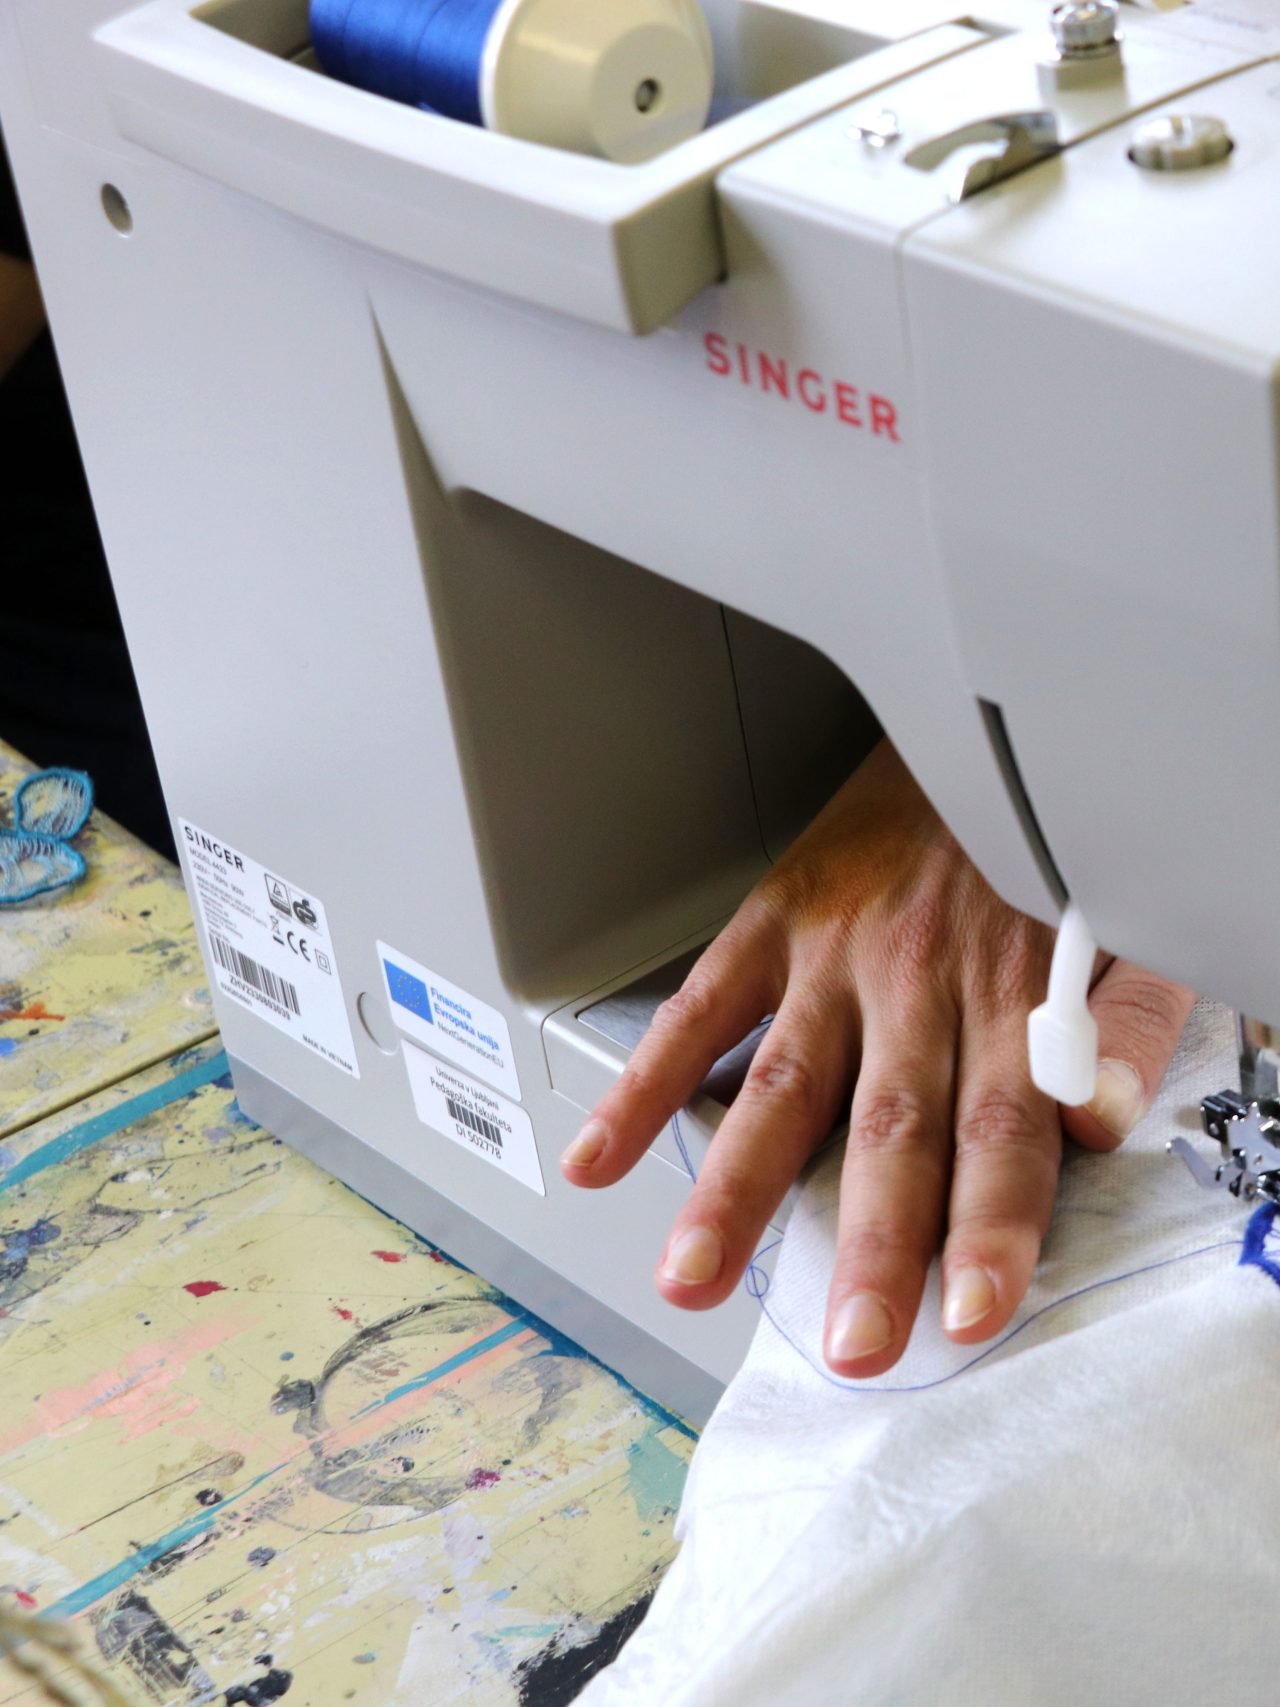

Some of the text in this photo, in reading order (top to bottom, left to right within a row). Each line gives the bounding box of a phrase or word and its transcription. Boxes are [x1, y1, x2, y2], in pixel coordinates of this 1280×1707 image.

[703, 331, 901, 443] SINGER
[184, 826, 245, 873] SINGER
[430, 986, 472, 1020] Financira
[434, 1002, 500, 1052] Evropska unija
[437, 1021, 505, 1069] NextGenerationEU
[430, 1076, 512, 1134] Pedagoška fakulteta
[435, 1066, 465, 1092] Univerza
[471, 1087, 499, 1111] Ljubljani
[467, 1129, 502, 1160] 502778
